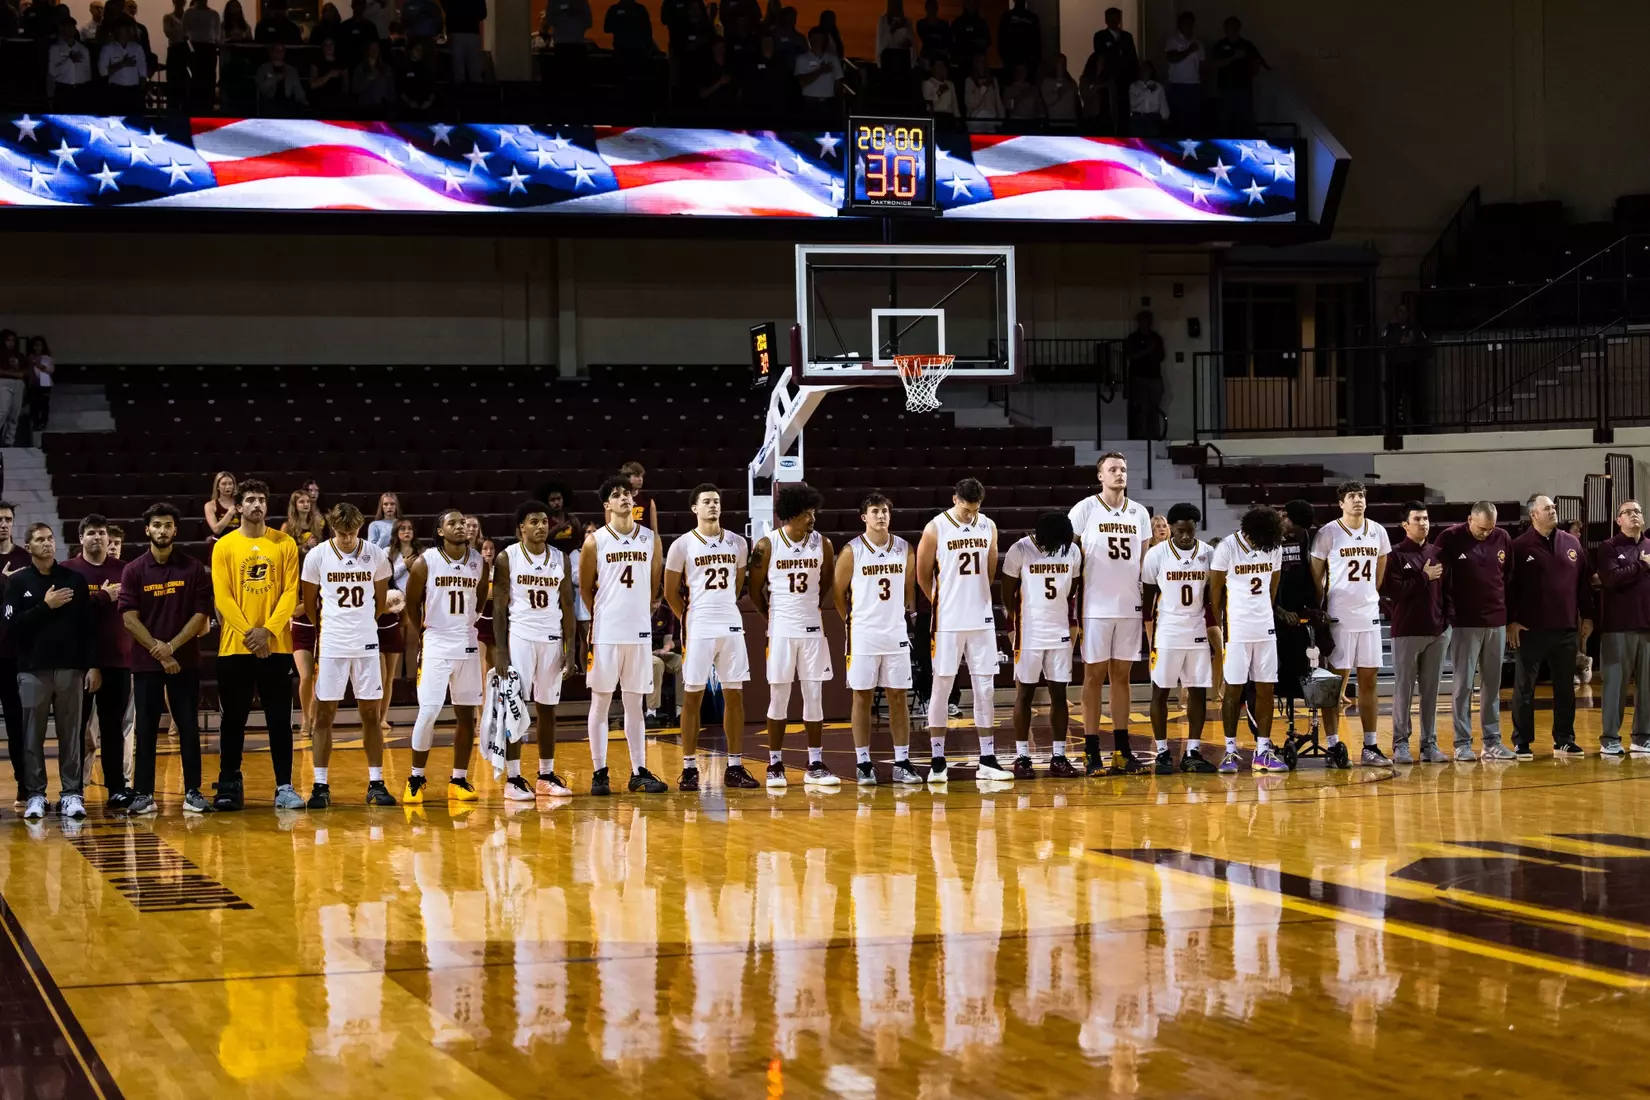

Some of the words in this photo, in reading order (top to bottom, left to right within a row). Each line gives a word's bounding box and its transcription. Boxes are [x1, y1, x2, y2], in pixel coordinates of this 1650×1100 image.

[857, 126, 923, 151] 20:00
[866, 154, 916, 197] 30
[1099, 523, 1136, 534] CHIPPEWAS
[947, 539, 987, 550] CHIPPEWAS
[1108, 537, 1131, 560] 55
[1340, 547, 1377, 557] CHIPPEWAS
[606, 552, 647, 563] CHIPPEWAS
[695, 554, 736, 566] CHIPPEWAS
[777, 559, 818, 569] CHIPPEWAS
[959, 552, 980, 575] 21
[327, 571, 371, 582] CHIPPEWAS
[620, 565, 634, 588] 4
[862, 564, 903, 575] CHIPPEWAS
[1029, 564, 1069, 574] CHIPPEWAS
[1167, 570, 1206, 582] CHIPPEWAS
[1235, 563, 1273, 575] CHIPPEWAS
[1348, 560, 1371, 581] 24
[435, 576, 477, 588] CHIPPEWAS
[517, 575, 558, 587] CHIPPEWAS
[705, 567, 729, 590] 23
[788, 573, 808, 593] 13
[1251, 577, 1262, 595] 2
[337, 586, 364, 608] 20
[879, 578, 890, 600] 3
[1045, 577, 1057, 599] 5
[1181, 585, 1193, 606] 0
[449, 591, 464, 614] 11
[528, 590, 548, 609] 10
